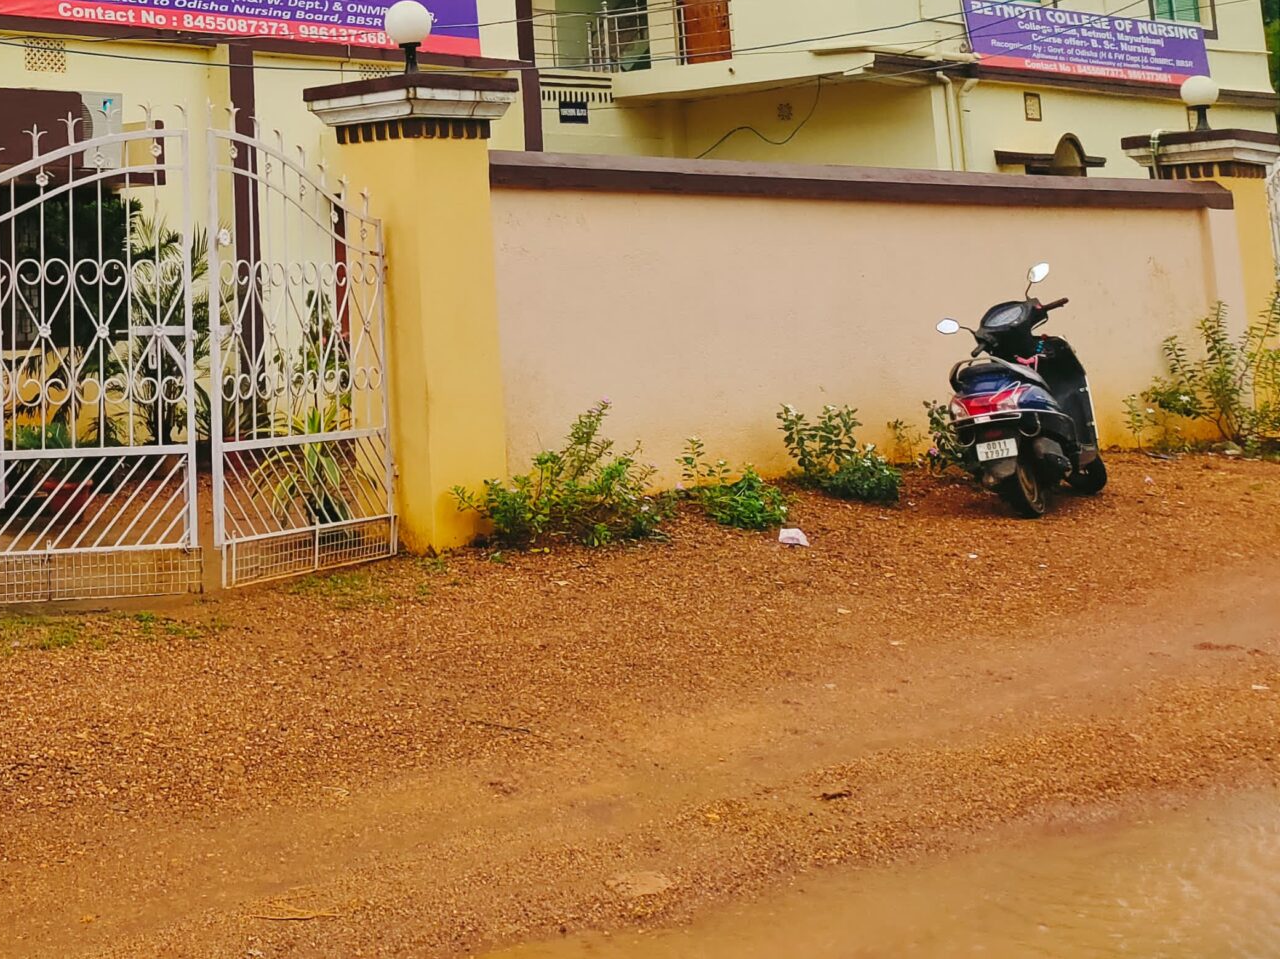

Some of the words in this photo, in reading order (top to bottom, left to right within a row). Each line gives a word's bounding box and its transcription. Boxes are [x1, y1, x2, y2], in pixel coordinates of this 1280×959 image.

[233, 5, 291, 20] Nursing
[295, 10, 343, 24] Board,
[346, 15, 383, 27] BBSR
[332, 2, 343, 12] &
[57, 2, 135, 23] Contact
[141, 10, 167, 25] No
[182, 13, 295, 39] 8455087373,
[970, 1, 1042, 21] BETNOTI
[1045, 10, 1111, 30] COLLEGE
[1114, 19, 1133, 36] OF
[1137, 21, 1199, 40] NURSING
[1017, 21, 1053, 34] College
[1120, 42, 1156, 56] Nursing
